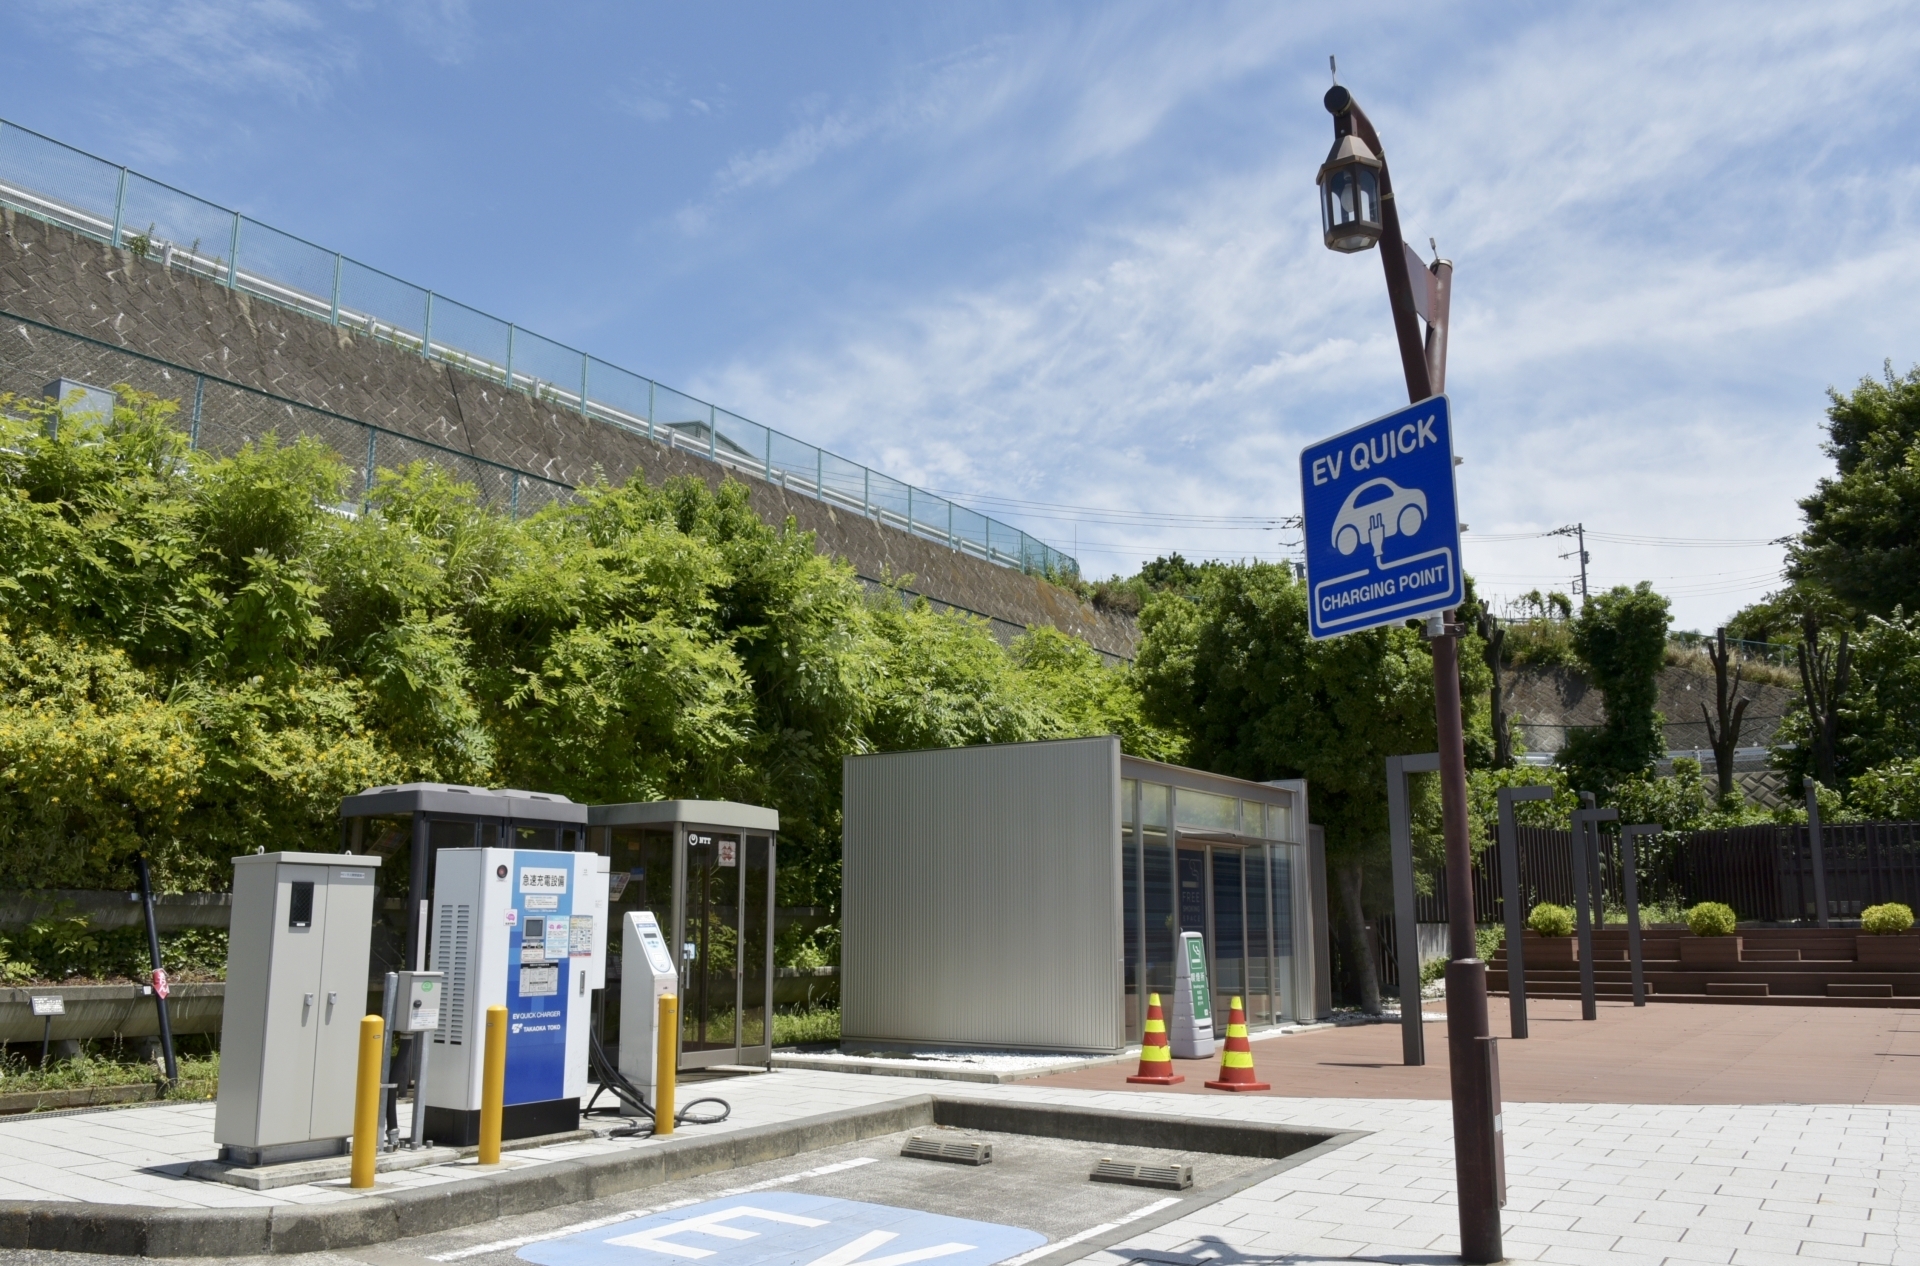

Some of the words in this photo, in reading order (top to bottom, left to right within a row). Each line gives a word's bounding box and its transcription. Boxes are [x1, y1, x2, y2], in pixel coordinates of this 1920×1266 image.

[1312, 450, 1343, 486] EV
[1350, 414, 1438, 471] QUICK
[1322, 579, 1396, 612] CHARGING
[1399, 565, 1445, 592] POINT
[699, 836, 712, 845] NTT
[522, 873, 565, 887] 急速充電設備
[1182, 891, 1200, 903] FREE
[1183, 914, 1201, 922] SPACE
[536, 1010, 561, 1018] CHARGER
[523, 1025, 547, 1033] TAKAOKA
